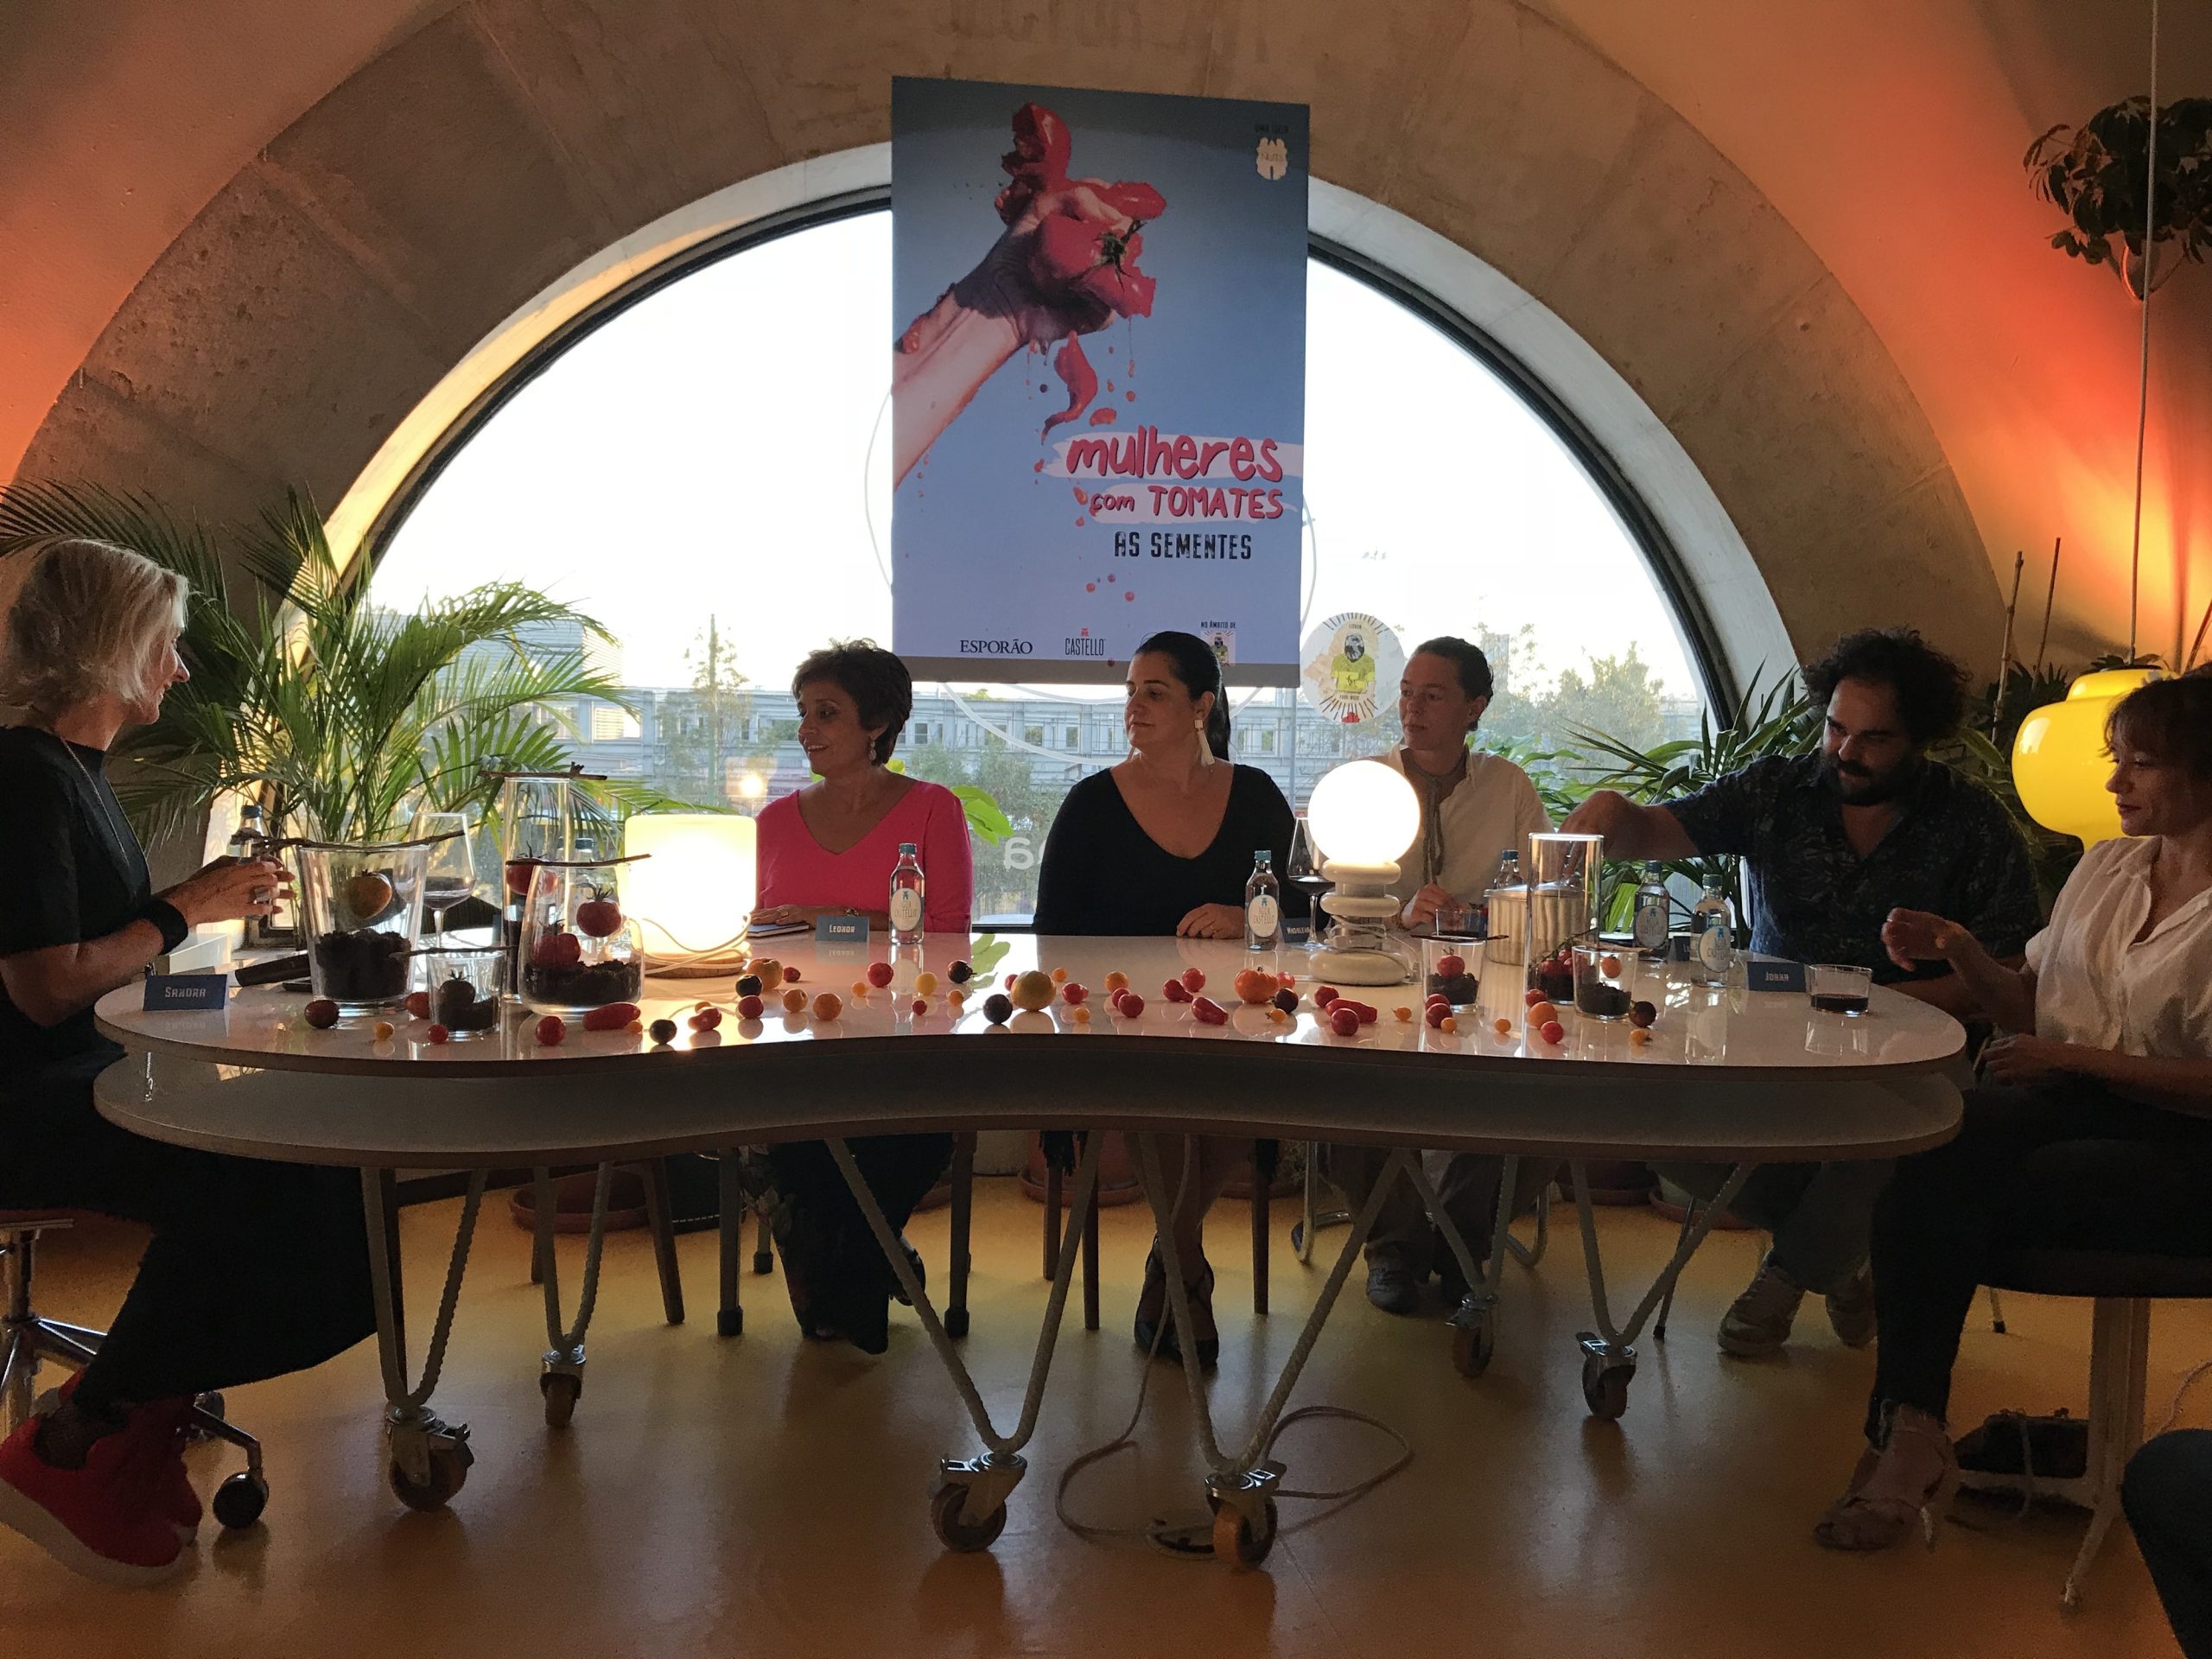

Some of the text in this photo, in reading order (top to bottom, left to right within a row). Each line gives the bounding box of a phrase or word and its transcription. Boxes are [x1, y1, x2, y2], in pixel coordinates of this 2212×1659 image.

[1066, 424, 1283, 483] mulheres
[1090, 485, 1283, 518] com TOMATES
[1114, 531, 1252, 560] AS SEMENTES
[960, 638, 1033, 655] ESPORÃO
[1065, 638, 1104, 657] CASTELLO
